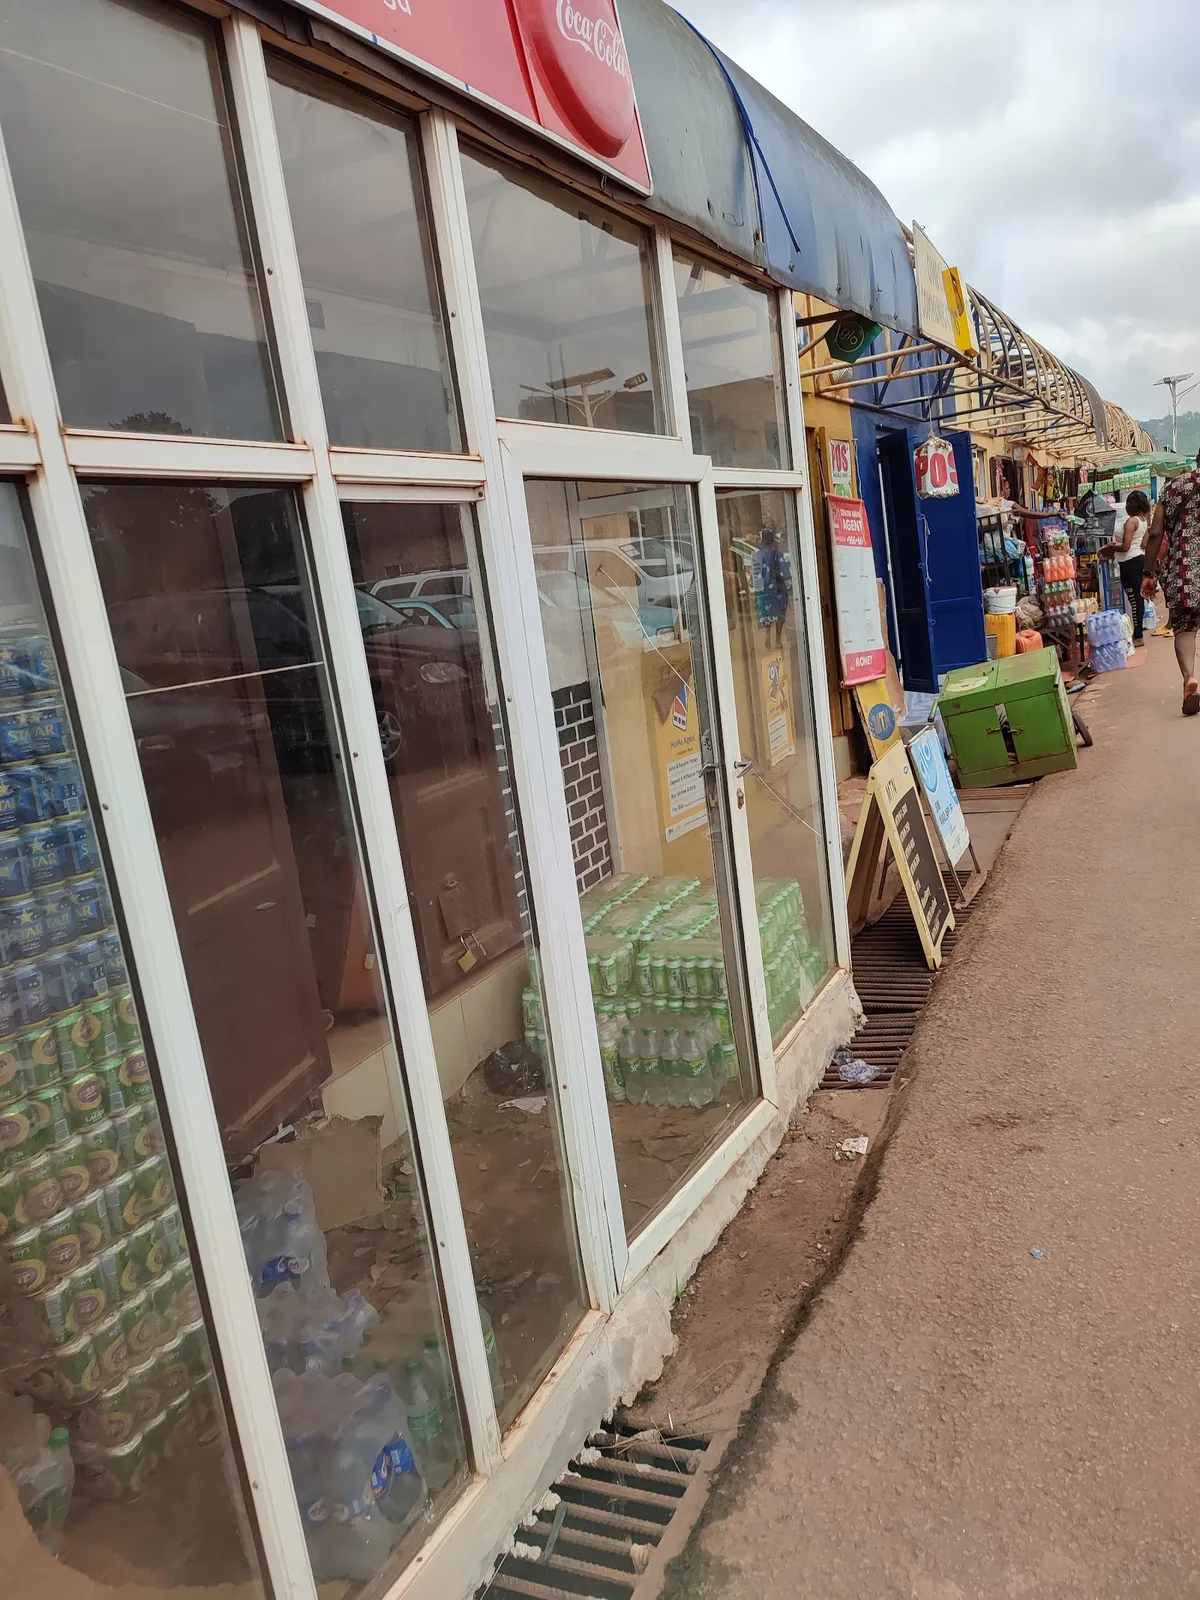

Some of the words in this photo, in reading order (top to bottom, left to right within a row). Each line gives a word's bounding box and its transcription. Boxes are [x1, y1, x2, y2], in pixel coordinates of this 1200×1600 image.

[841, 328, 858, 345] glo
[831, 444, 848, 472] POS
[842, 519, 863, 532] AGENT
[872, 709, 891, 734] MTN
